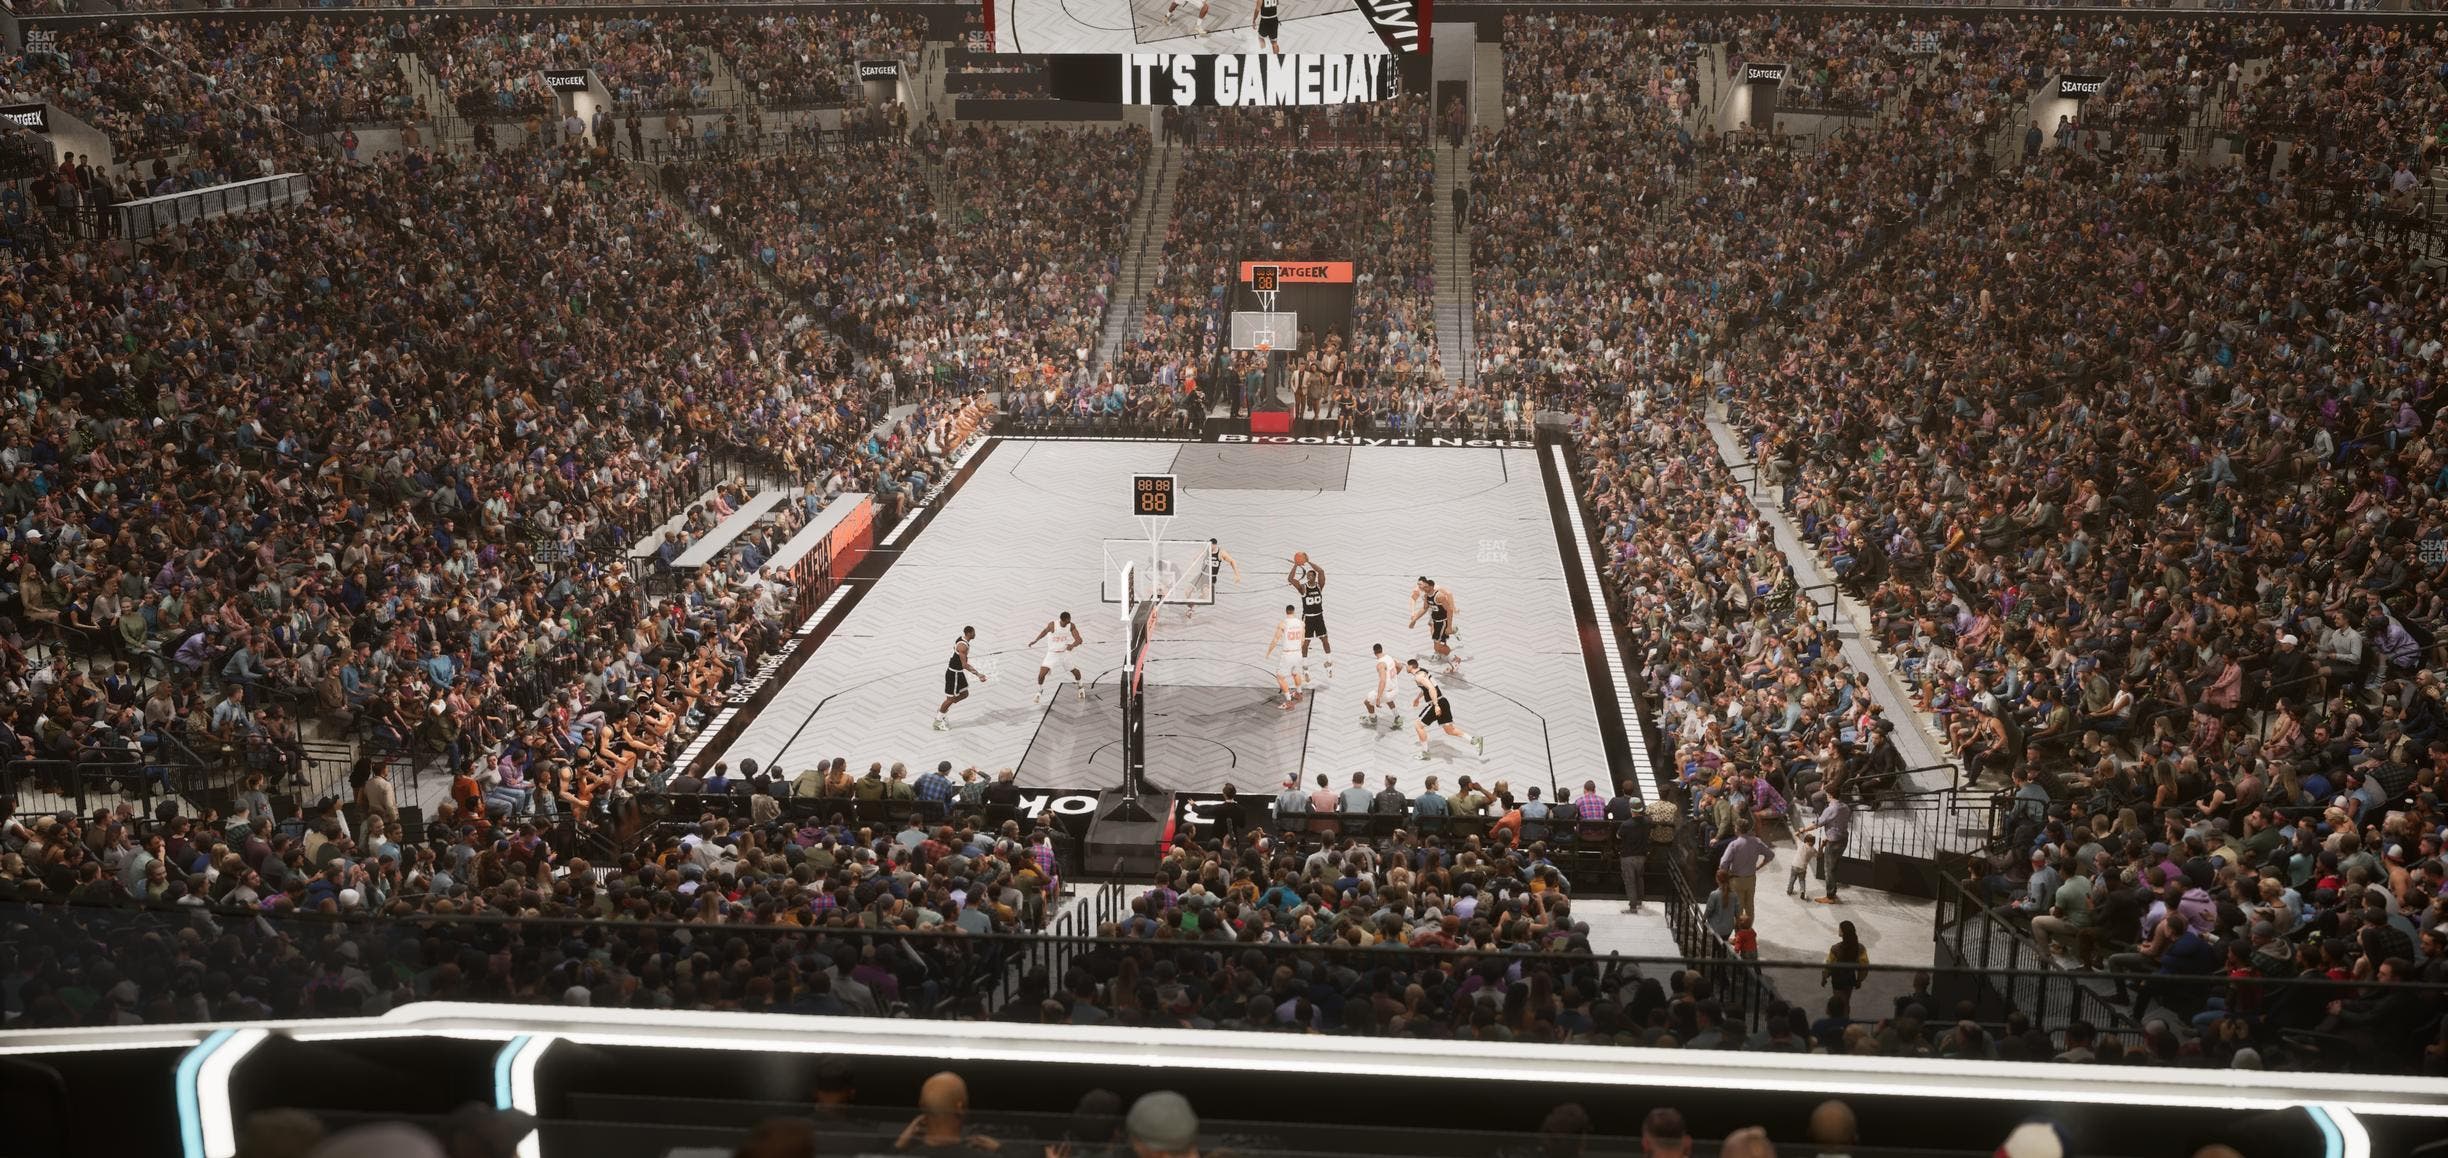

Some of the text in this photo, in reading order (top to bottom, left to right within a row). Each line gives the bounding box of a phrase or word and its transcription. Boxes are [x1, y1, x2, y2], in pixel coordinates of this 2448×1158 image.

[861, 65, 897, 76] SEATGEEK
[1748, 68, 1782, 80] SEATGEEK
[546, 76, 586, 87] SEATGEEK
[1122, 53, 1196, 106] IT'S
[1214, 53, 1382, 106] GAMEDAY
[1218, 434, 1416, 448] Brooklyn
[1138, 480, 1170, 491] 88 88
[1141, 492, 1167, 511] 88
